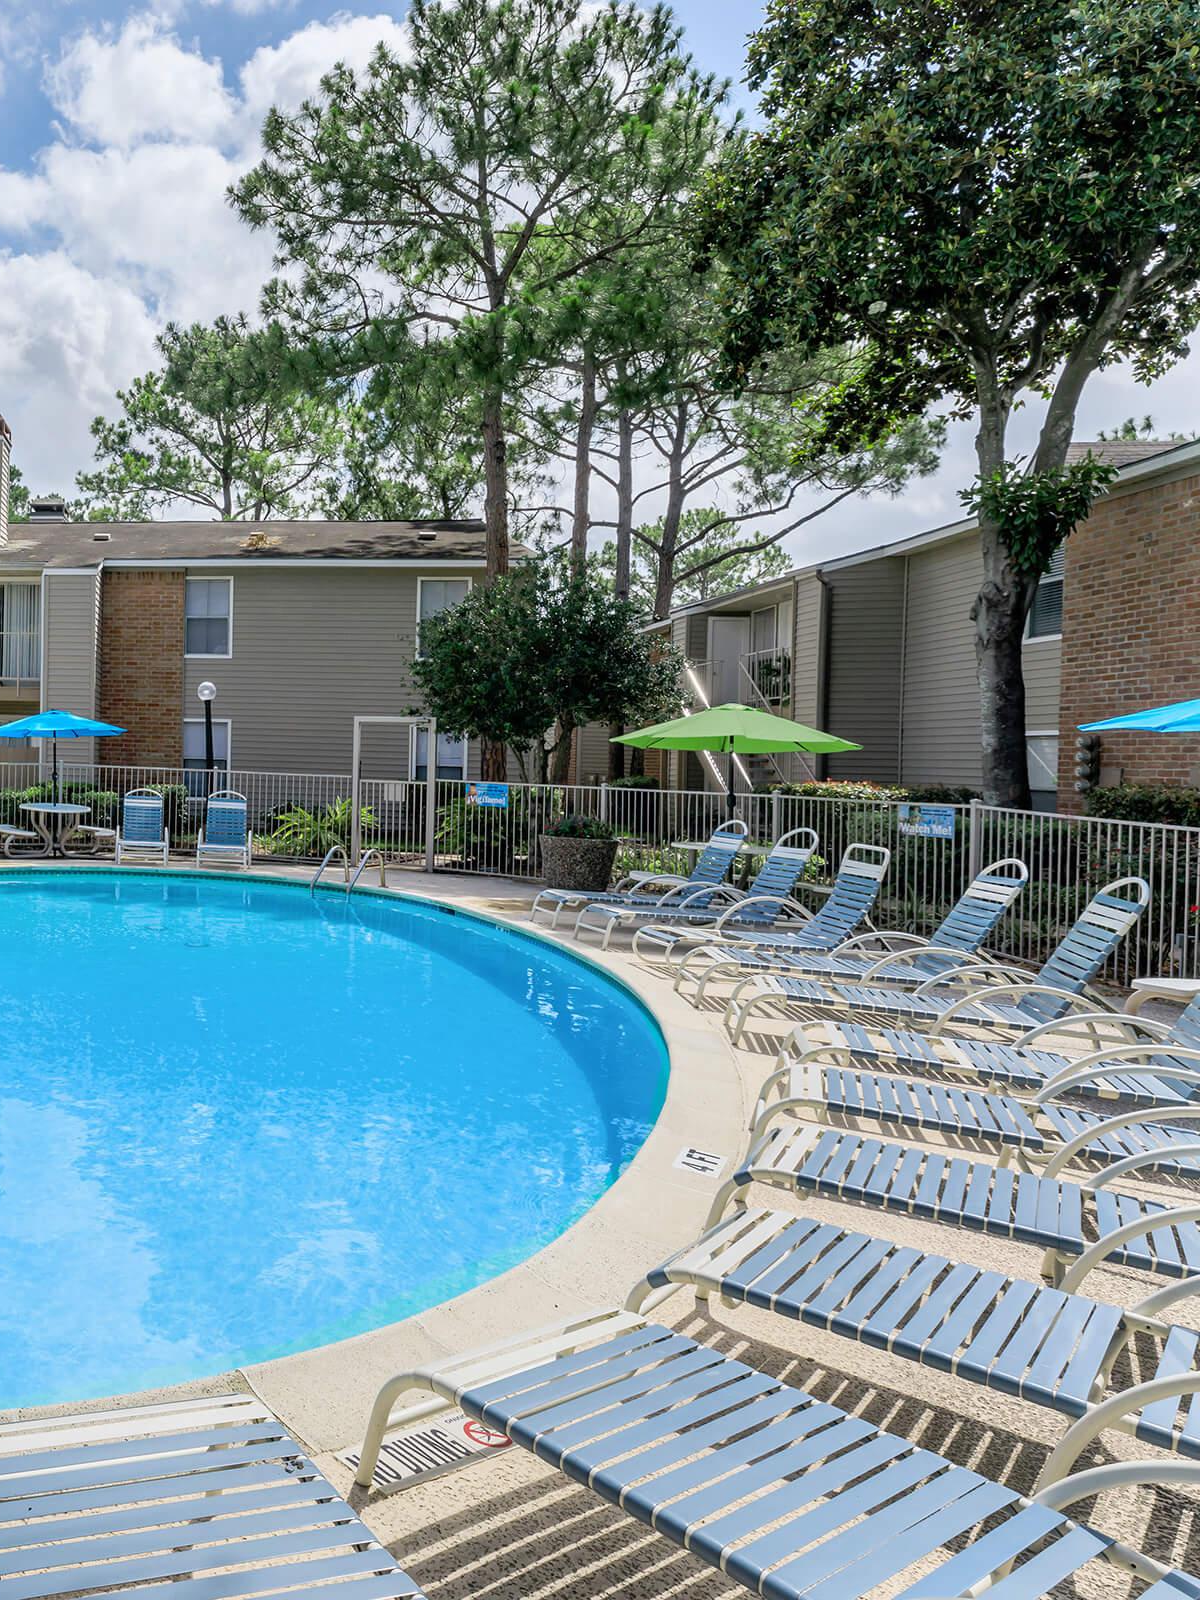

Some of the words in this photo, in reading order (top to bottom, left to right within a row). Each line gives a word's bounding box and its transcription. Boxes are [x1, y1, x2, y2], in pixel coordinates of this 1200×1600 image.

[899, 822, 930, 834] Watch
[932, 824, 952, 836] Me!
[381, 1428, 474, 1474] DIVING
